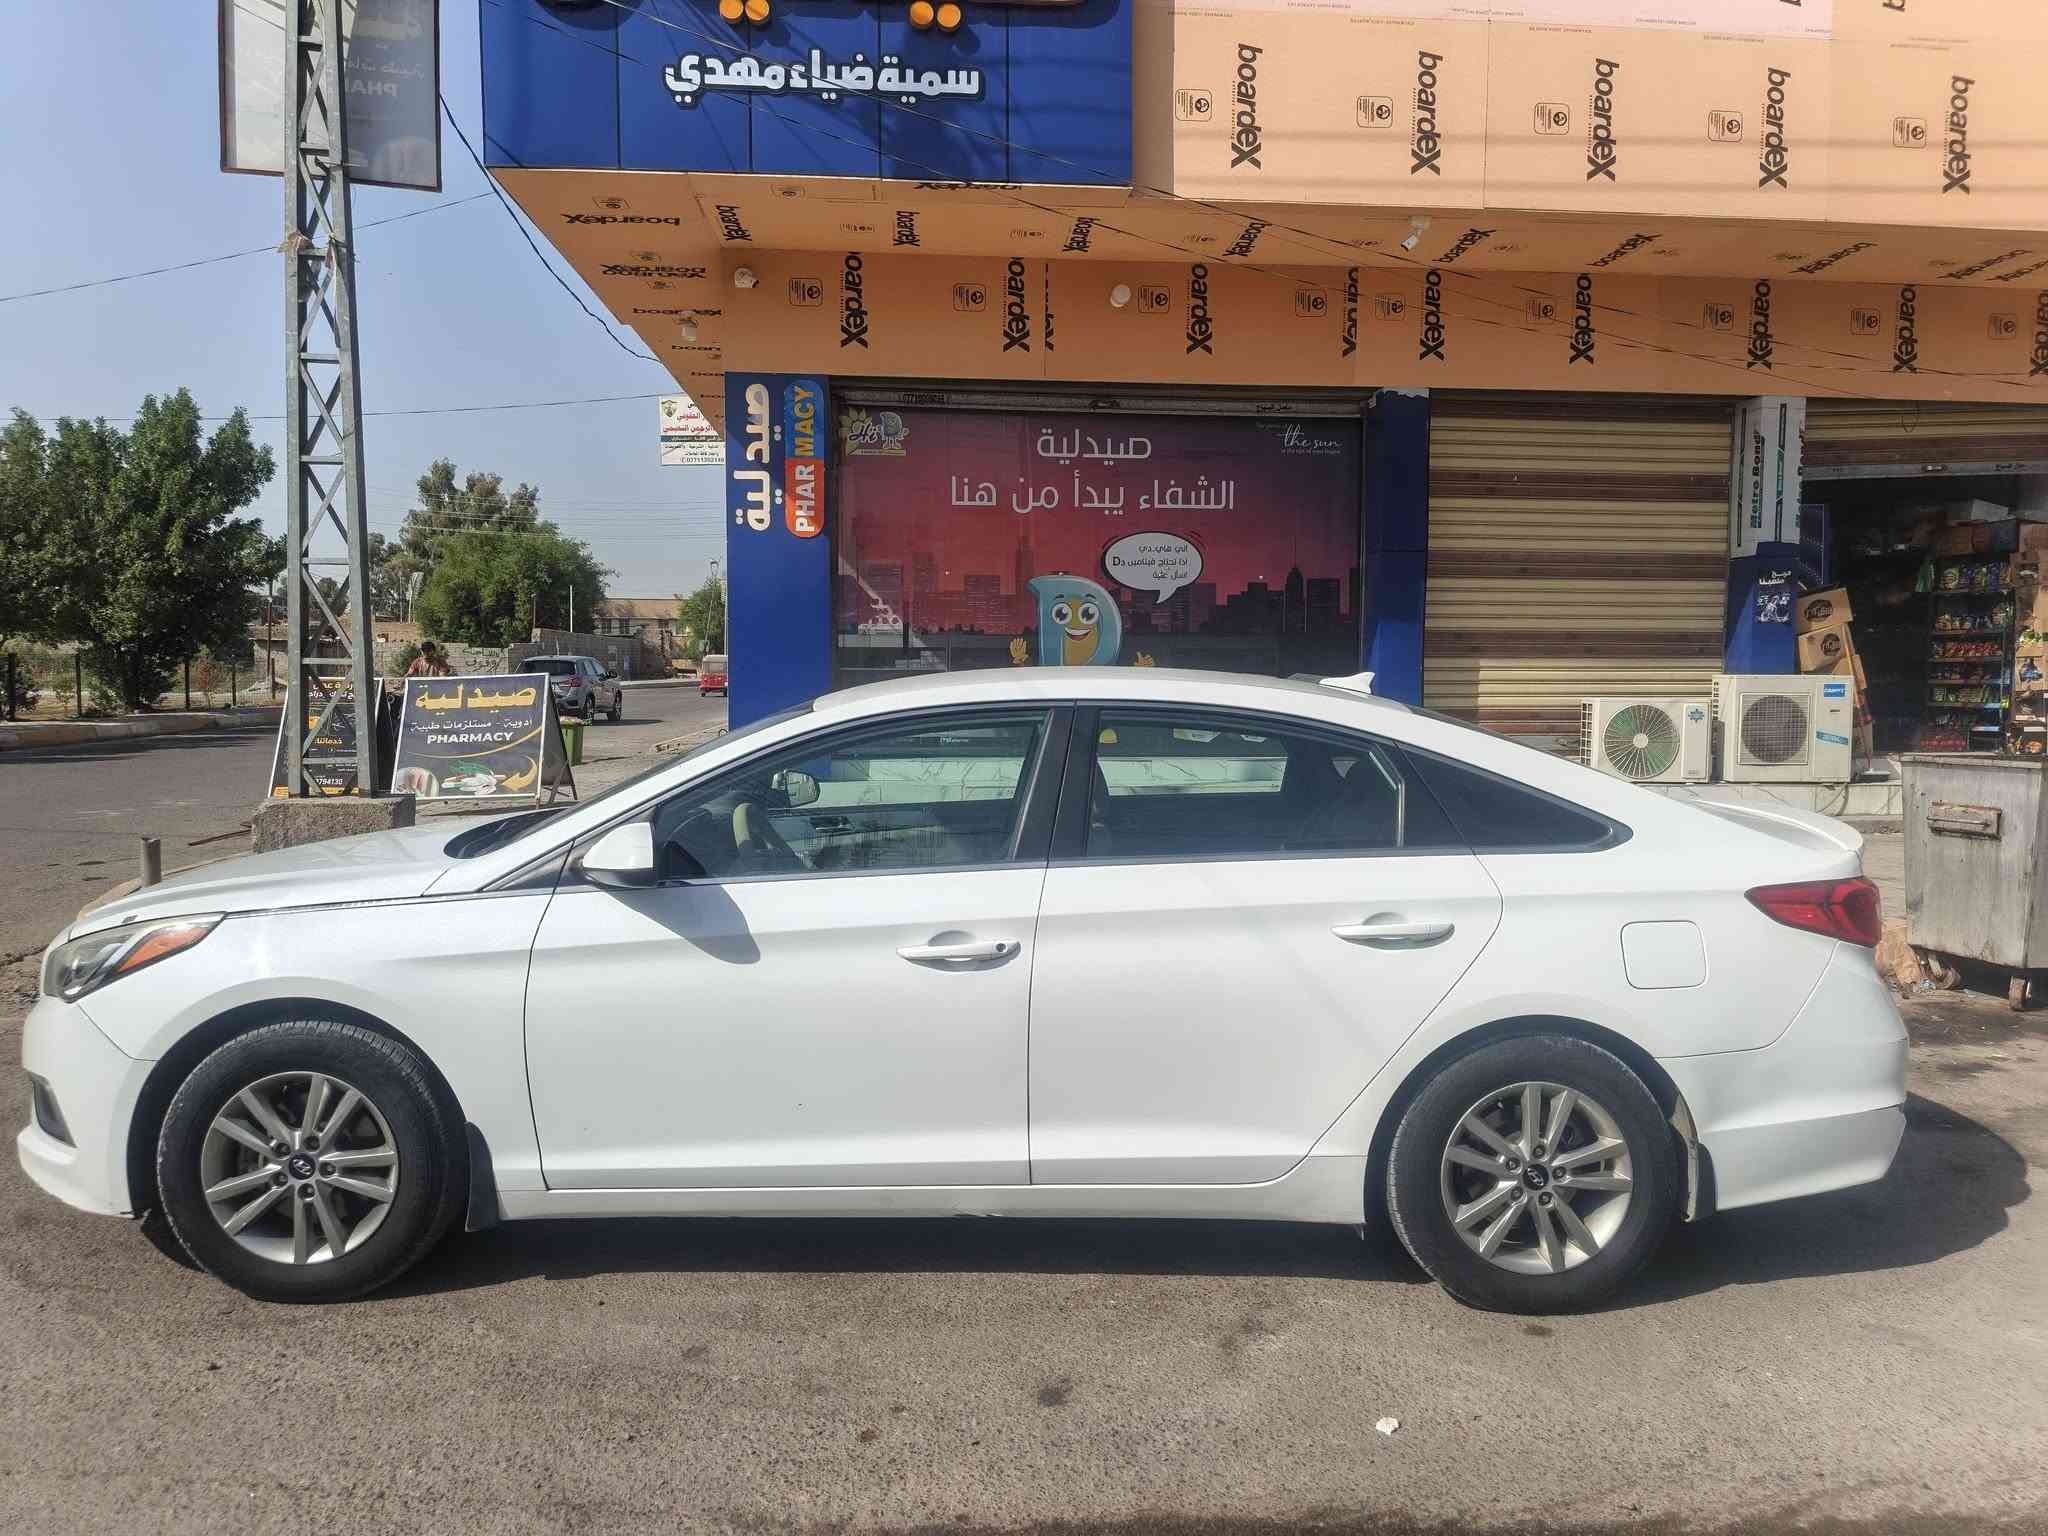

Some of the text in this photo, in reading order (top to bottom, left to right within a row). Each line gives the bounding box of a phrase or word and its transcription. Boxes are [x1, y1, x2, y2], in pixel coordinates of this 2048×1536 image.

[664, 50, 980, 104] سمية ضياء مهدي
[734, 383, 783, 531] صيدلية
[1037, 427, 1153, 466] صيدلية
[951, 469, 1235, 516] الشفاء يبدأ من هنا
[415, 682, 538, 716] صيدلية
[426, 731, 514, 744] PHARMACY
